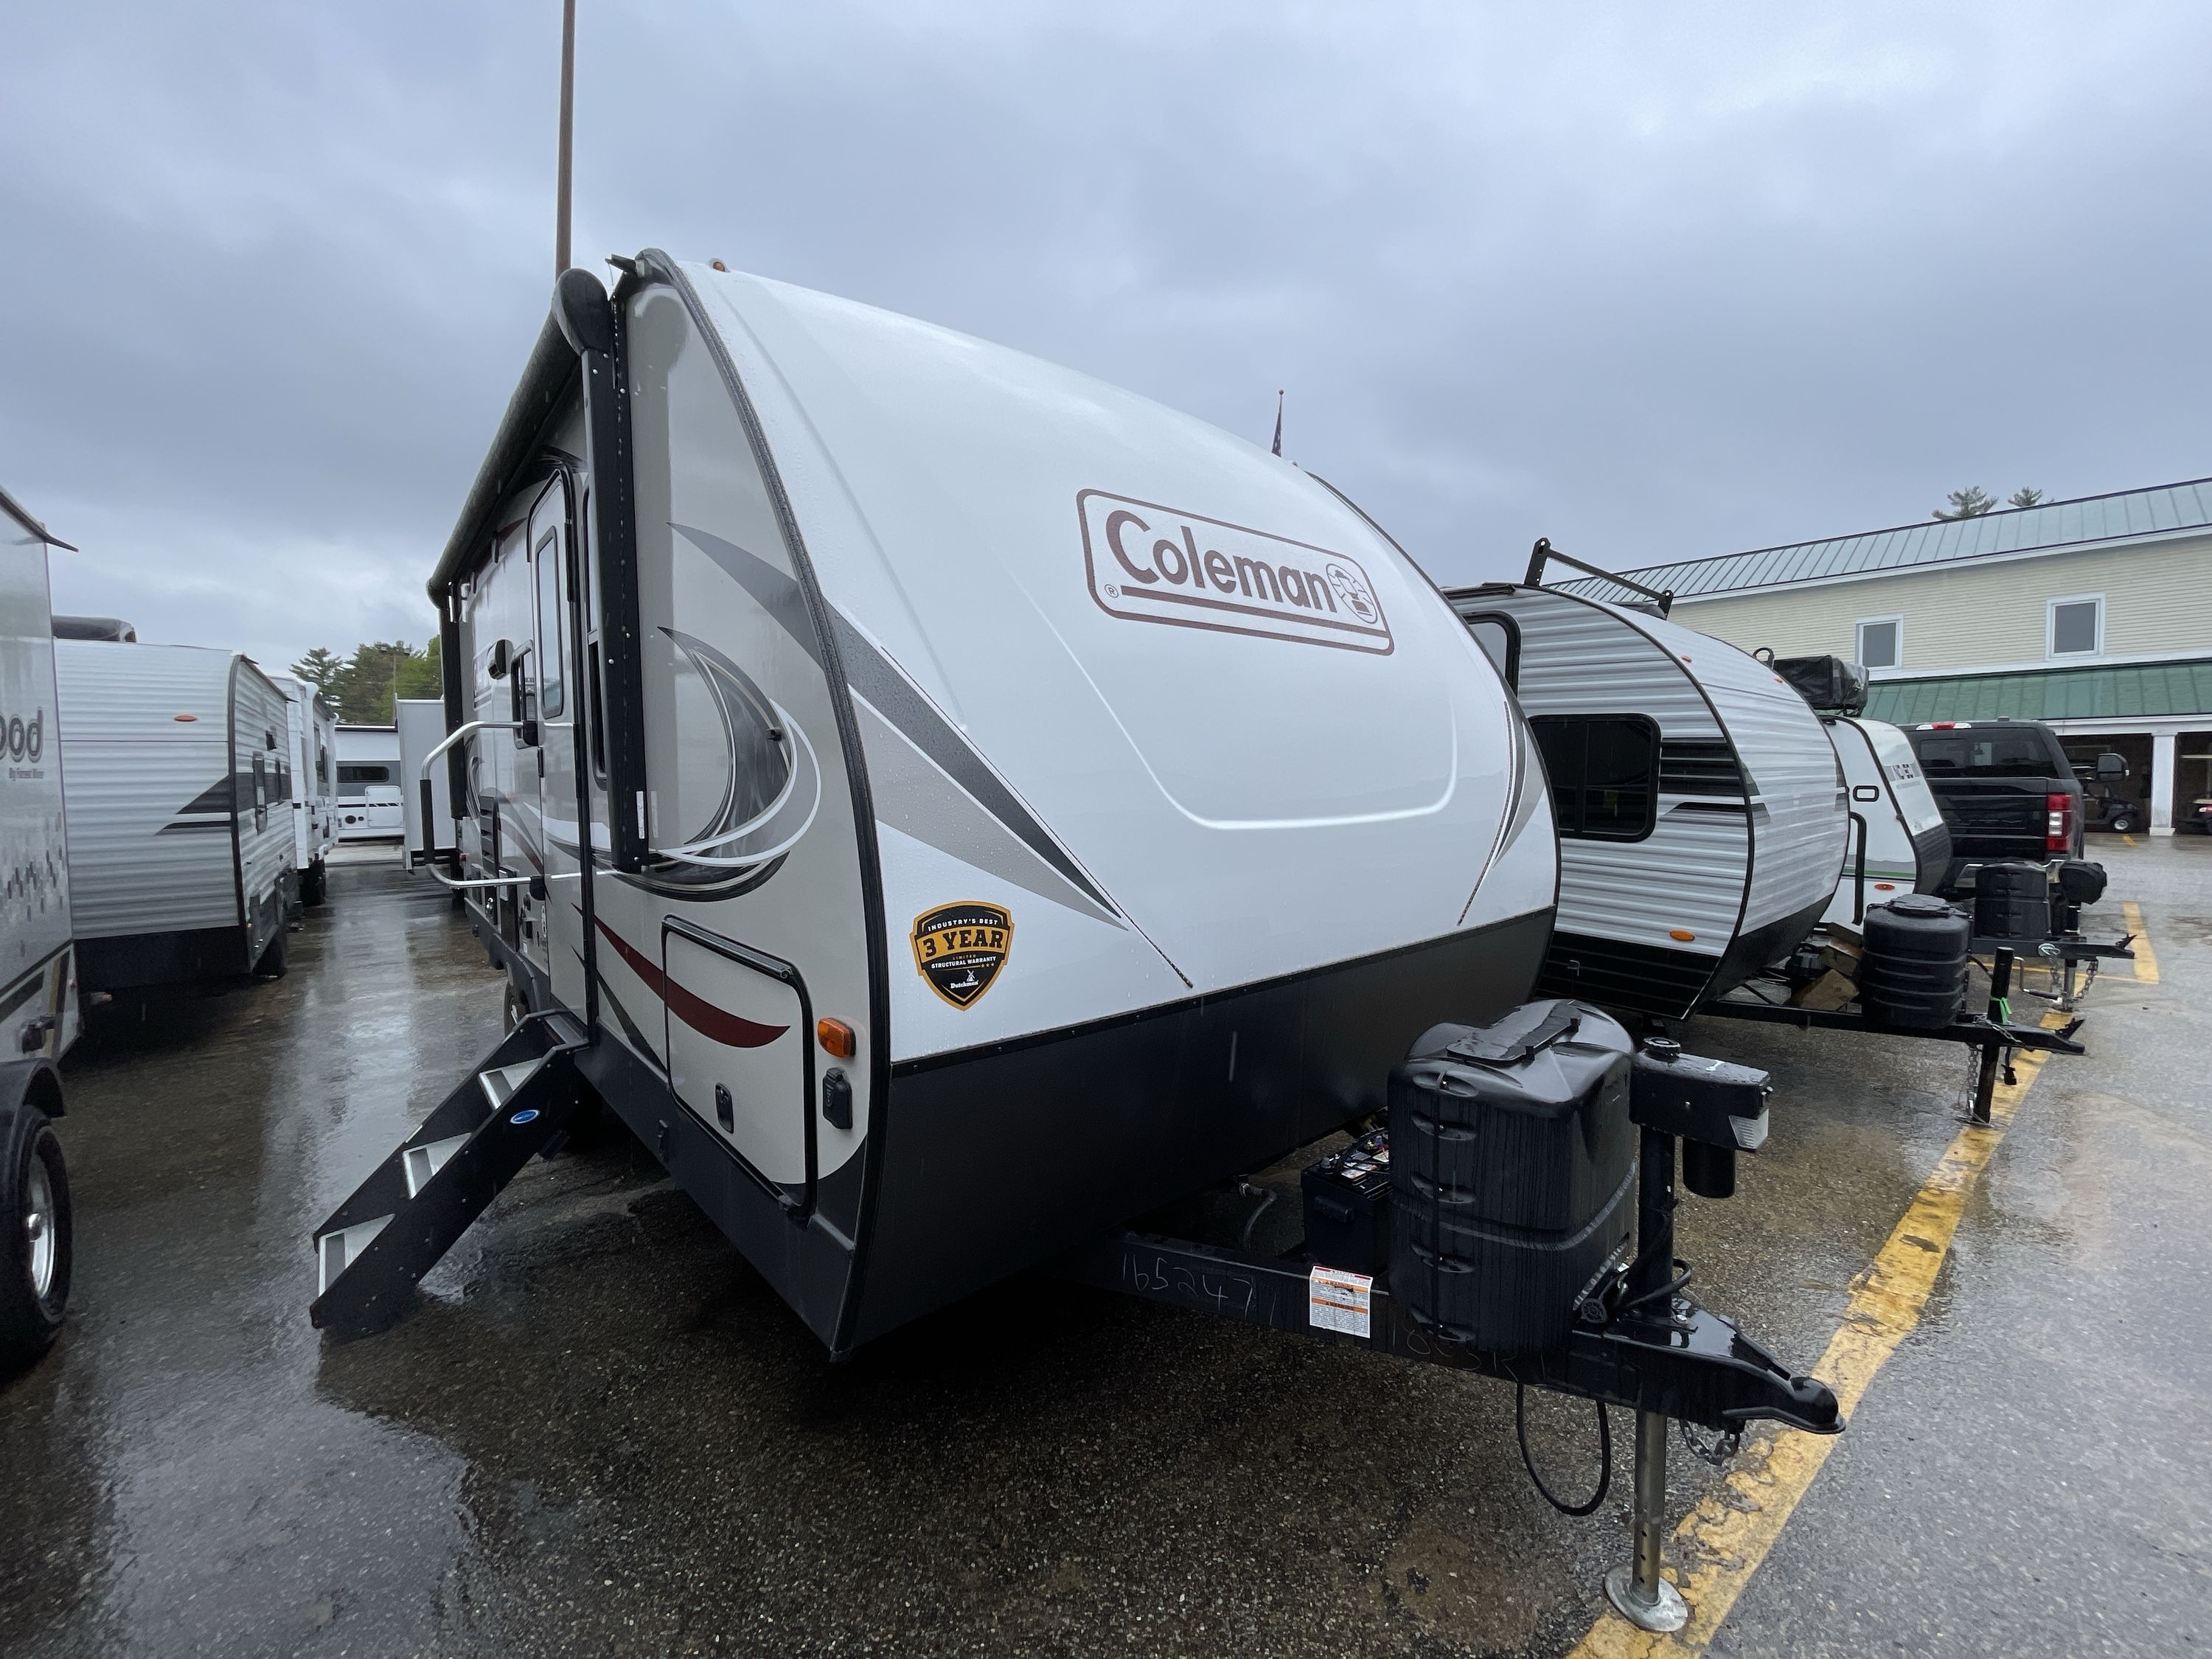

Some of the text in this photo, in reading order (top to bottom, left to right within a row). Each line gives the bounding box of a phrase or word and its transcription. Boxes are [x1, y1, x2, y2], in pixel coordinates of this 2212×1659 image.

[1105, 509, 1338, 613] Coleman
[928, 918, 976, 931] INDUSTRY'S
[923, 929, 1004, 958] 3 YEAR
[931, 956, 997, 969] STRUCTURAL WARRANTY
